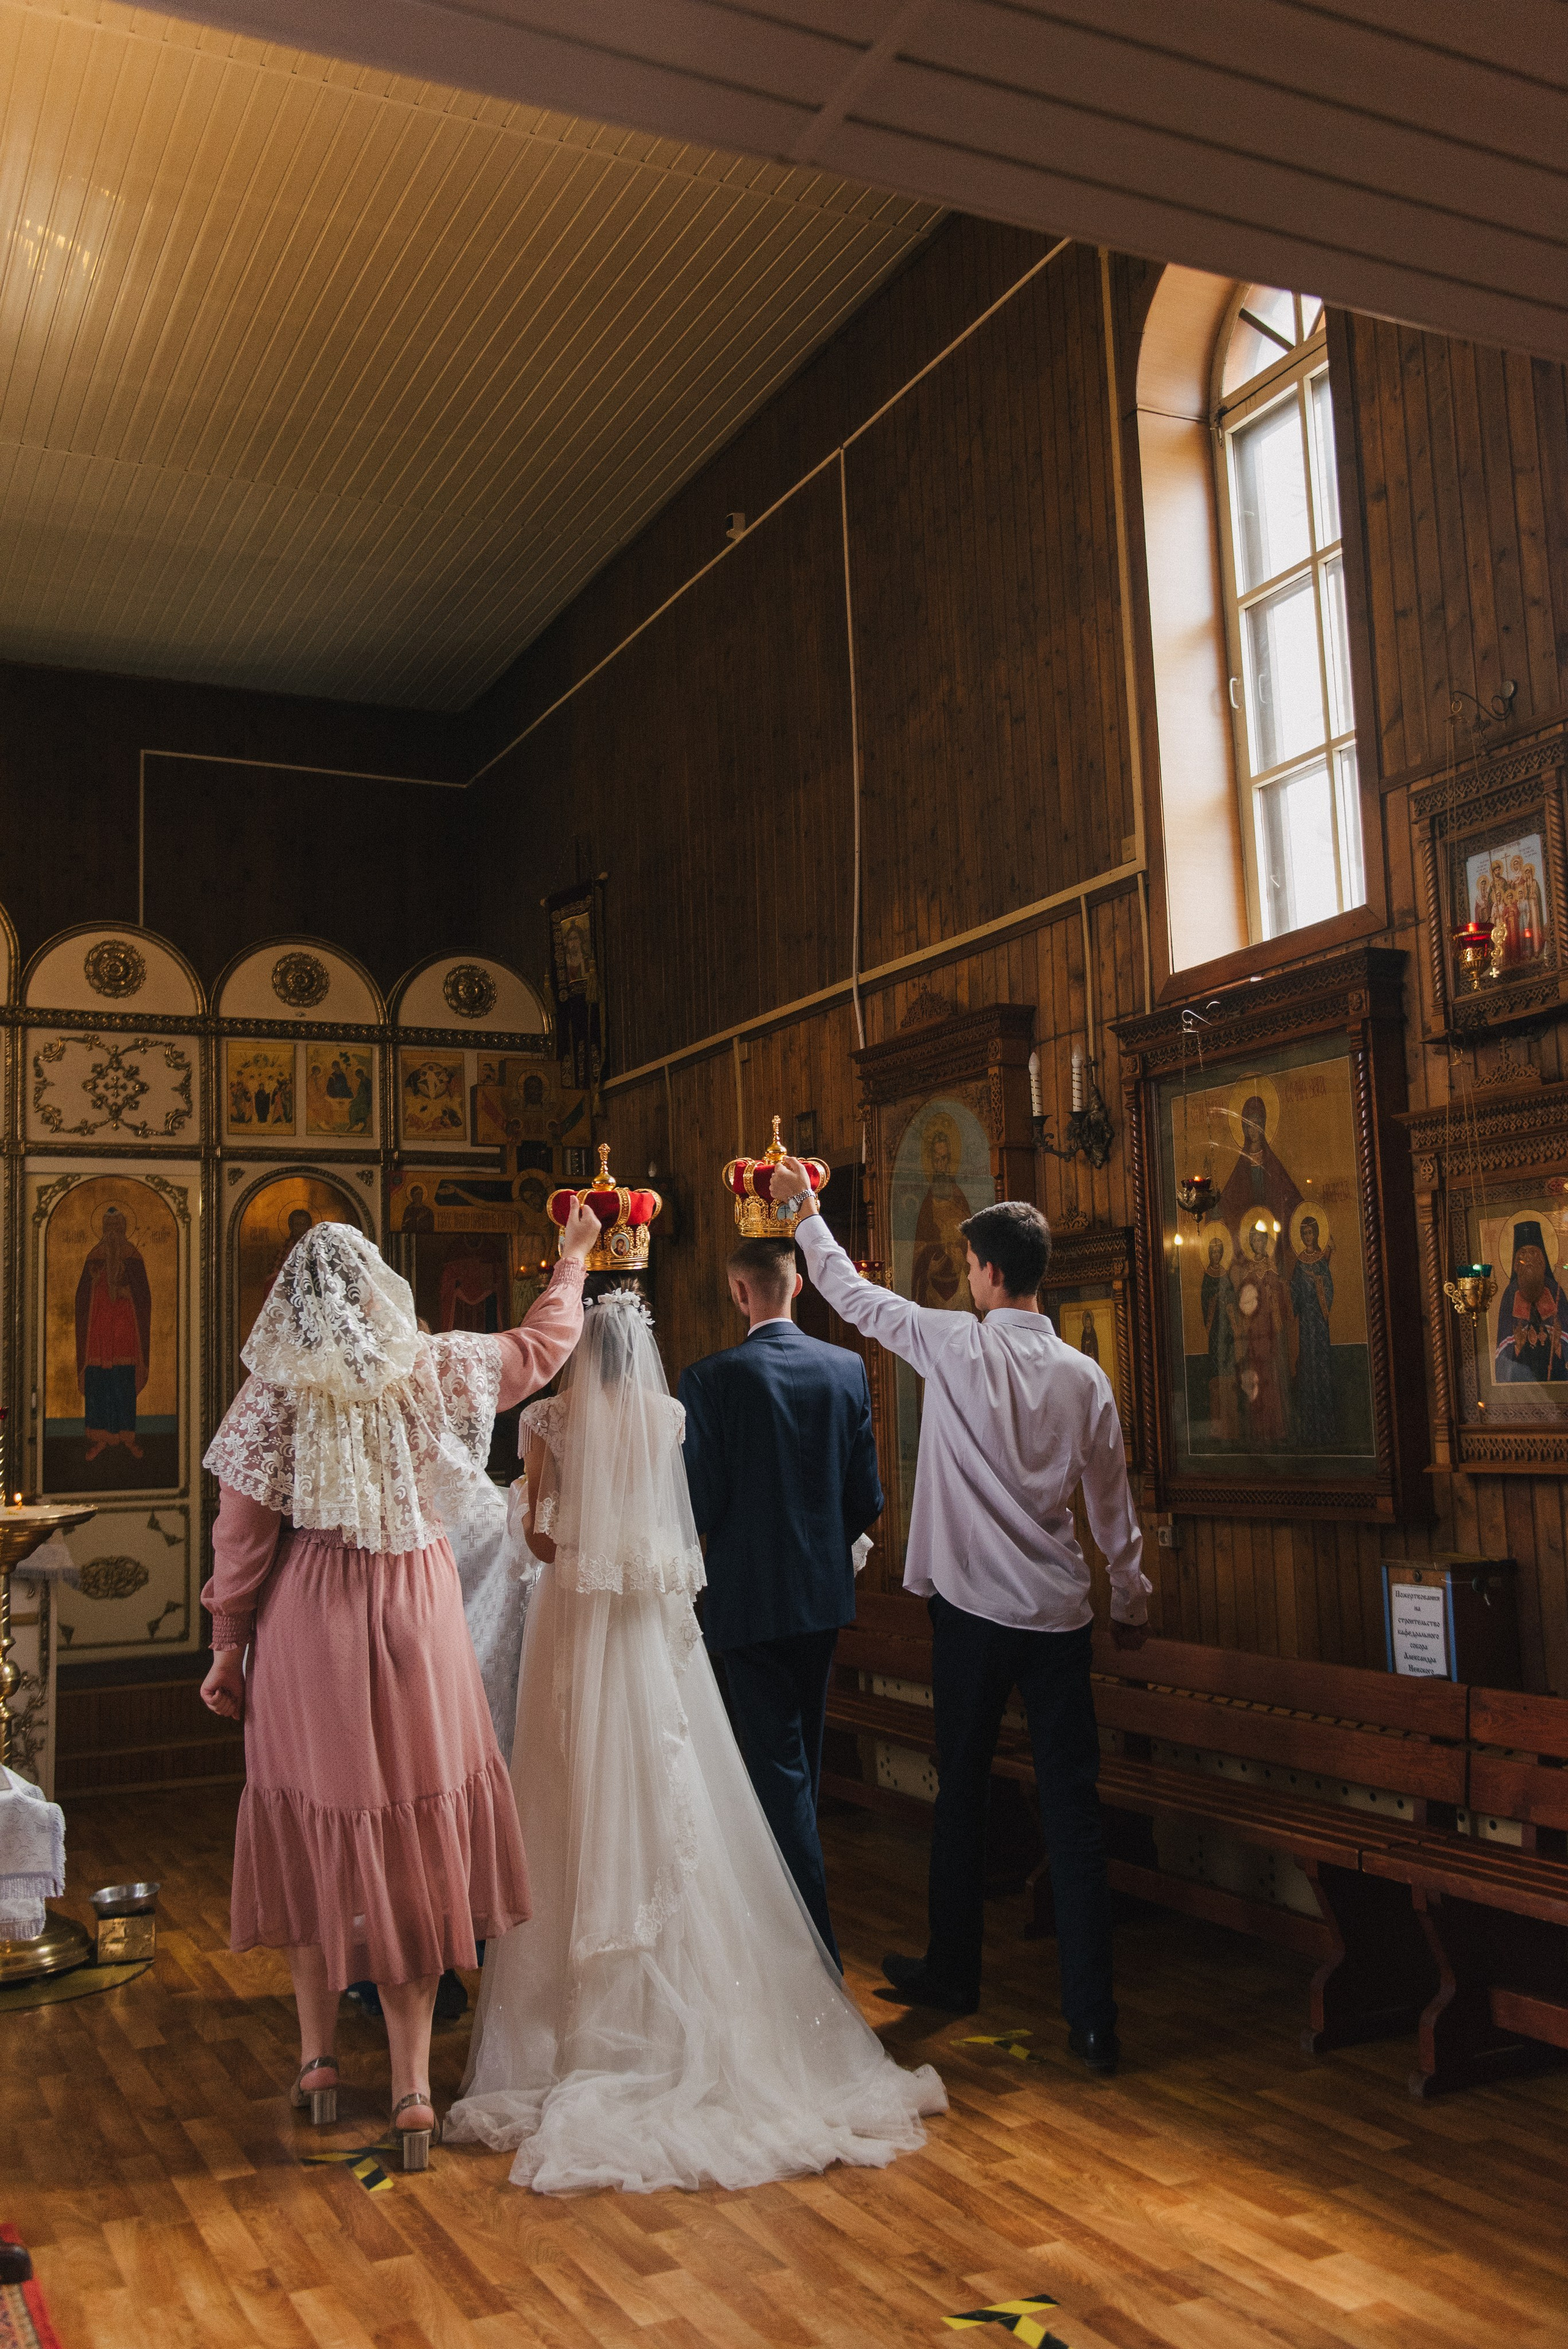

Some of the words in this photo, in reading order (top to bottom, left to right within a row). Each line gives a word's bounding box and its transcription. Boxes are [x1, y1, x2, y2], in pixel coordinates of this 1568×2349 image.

[1395, 1591, 1441, 1601] Пожертвования
[1398, 1618, 1441, 1627] строительство
[1398, 1629, 1439, 1640] кафедрального
